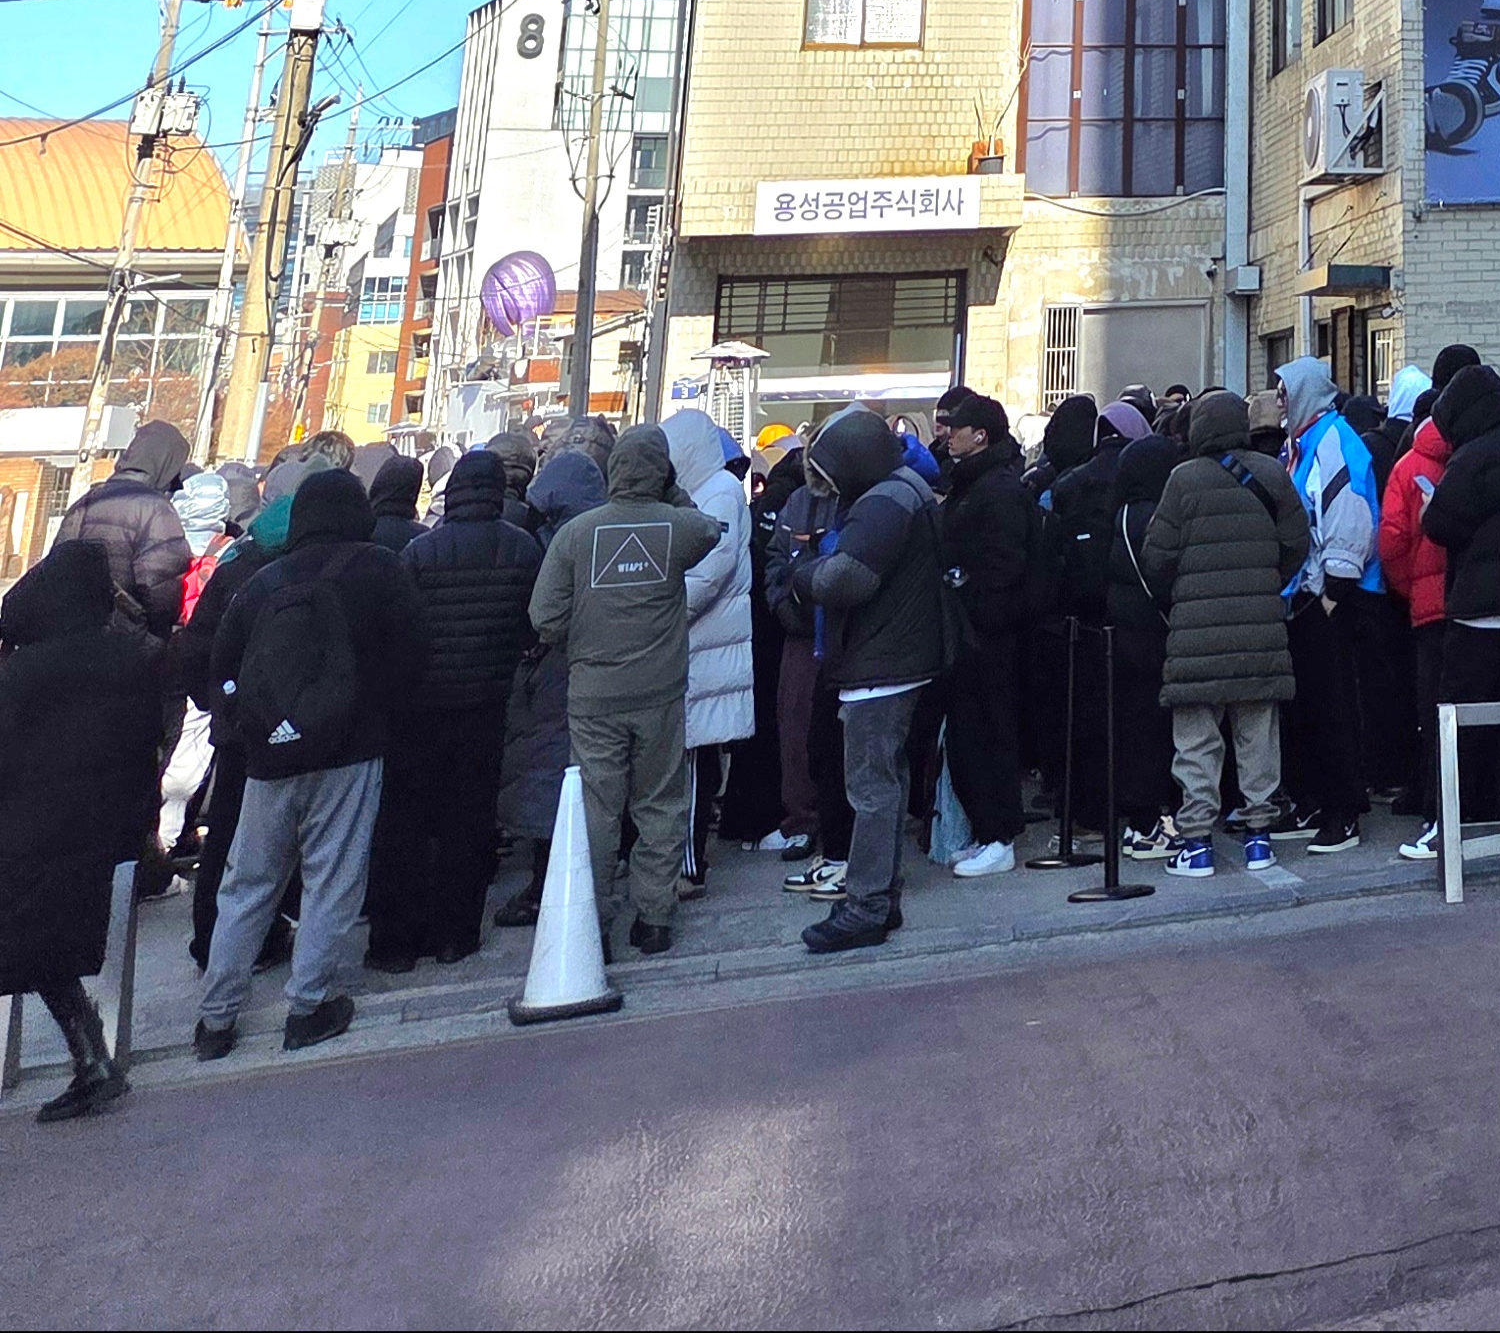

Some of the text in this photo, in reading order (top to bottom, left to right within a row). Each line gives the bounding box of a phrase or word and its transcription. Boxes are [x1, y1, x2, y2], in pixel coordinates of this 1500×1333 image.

[517, 13, 545, 59] 8
[773, 187, 964, 222] 용성공업주식회사
[268, 733, 301, 744] adidas
